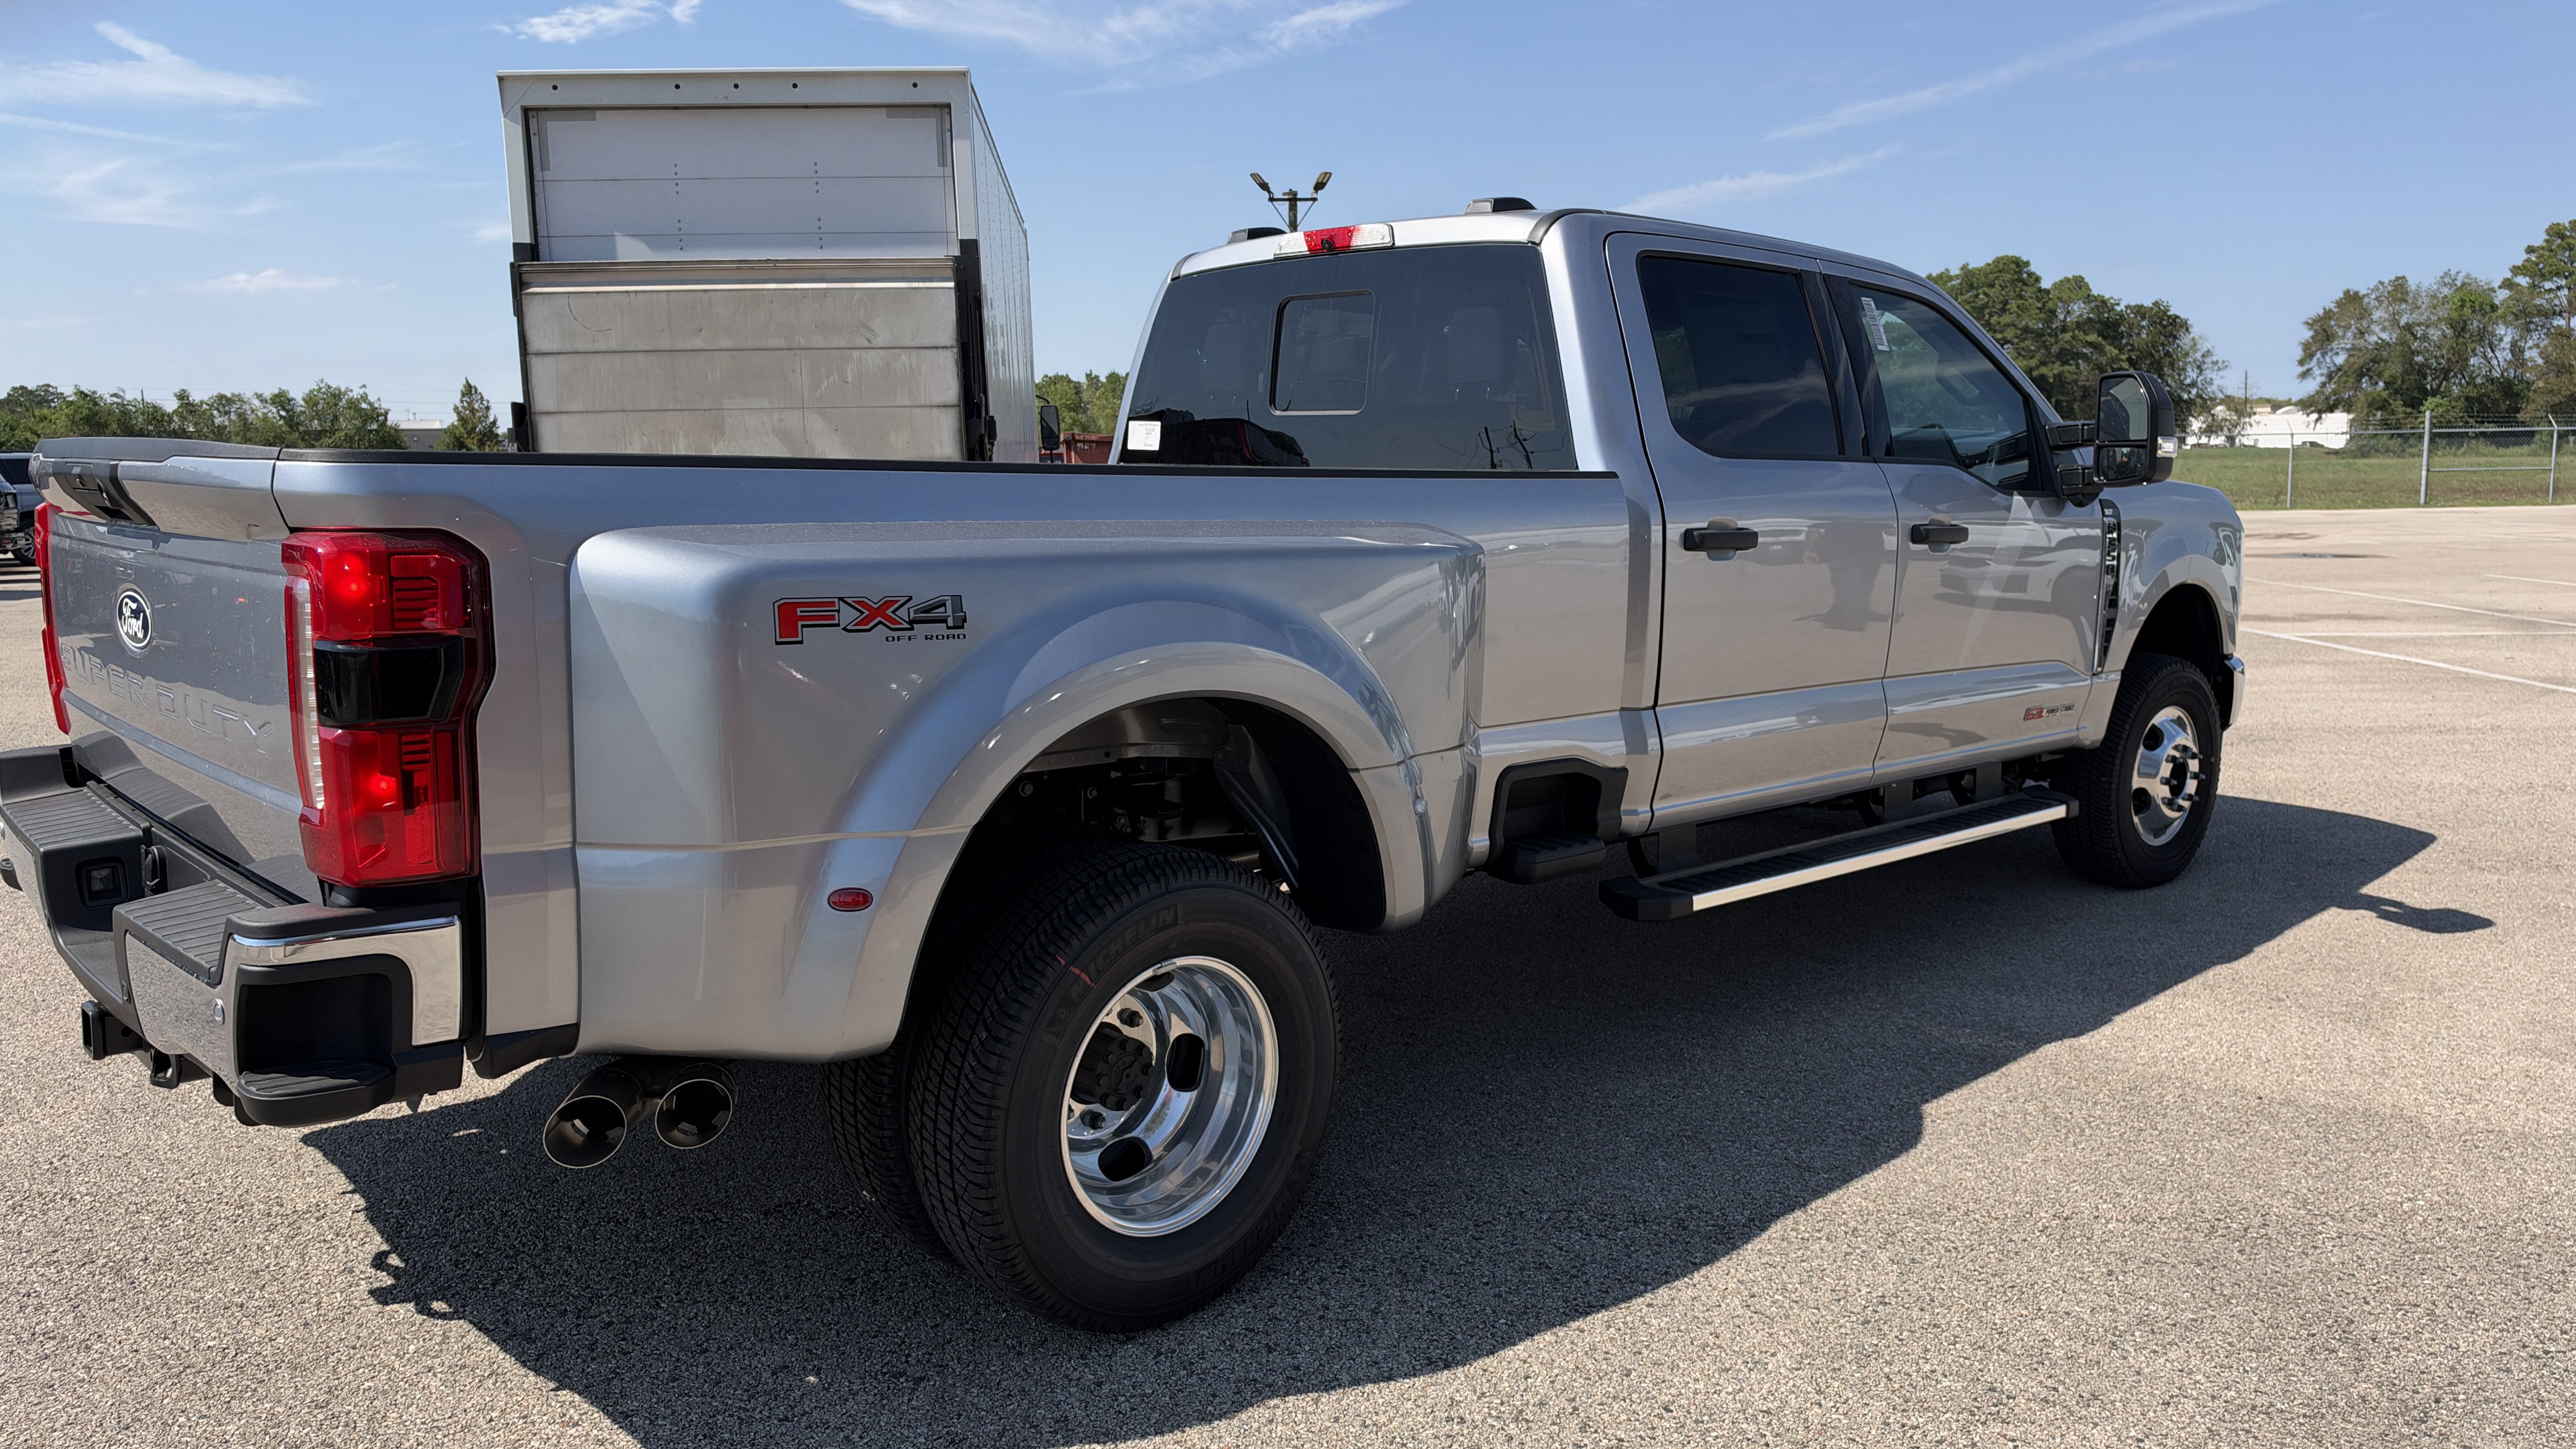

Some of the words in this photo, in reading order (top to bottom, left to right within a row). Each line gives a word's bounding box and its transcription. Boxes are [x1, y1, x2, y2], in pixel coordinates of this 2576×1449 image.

[122, 598, 144, 639] Ford
[773, 595, 967, 645] FX4
[925, 633, 966, 641] ROAD
[61, 643, 148, 709] SUPER
[156, 683, 273, 754] DUTY
[1072, 906, 1178, 1005] MICHELIN
